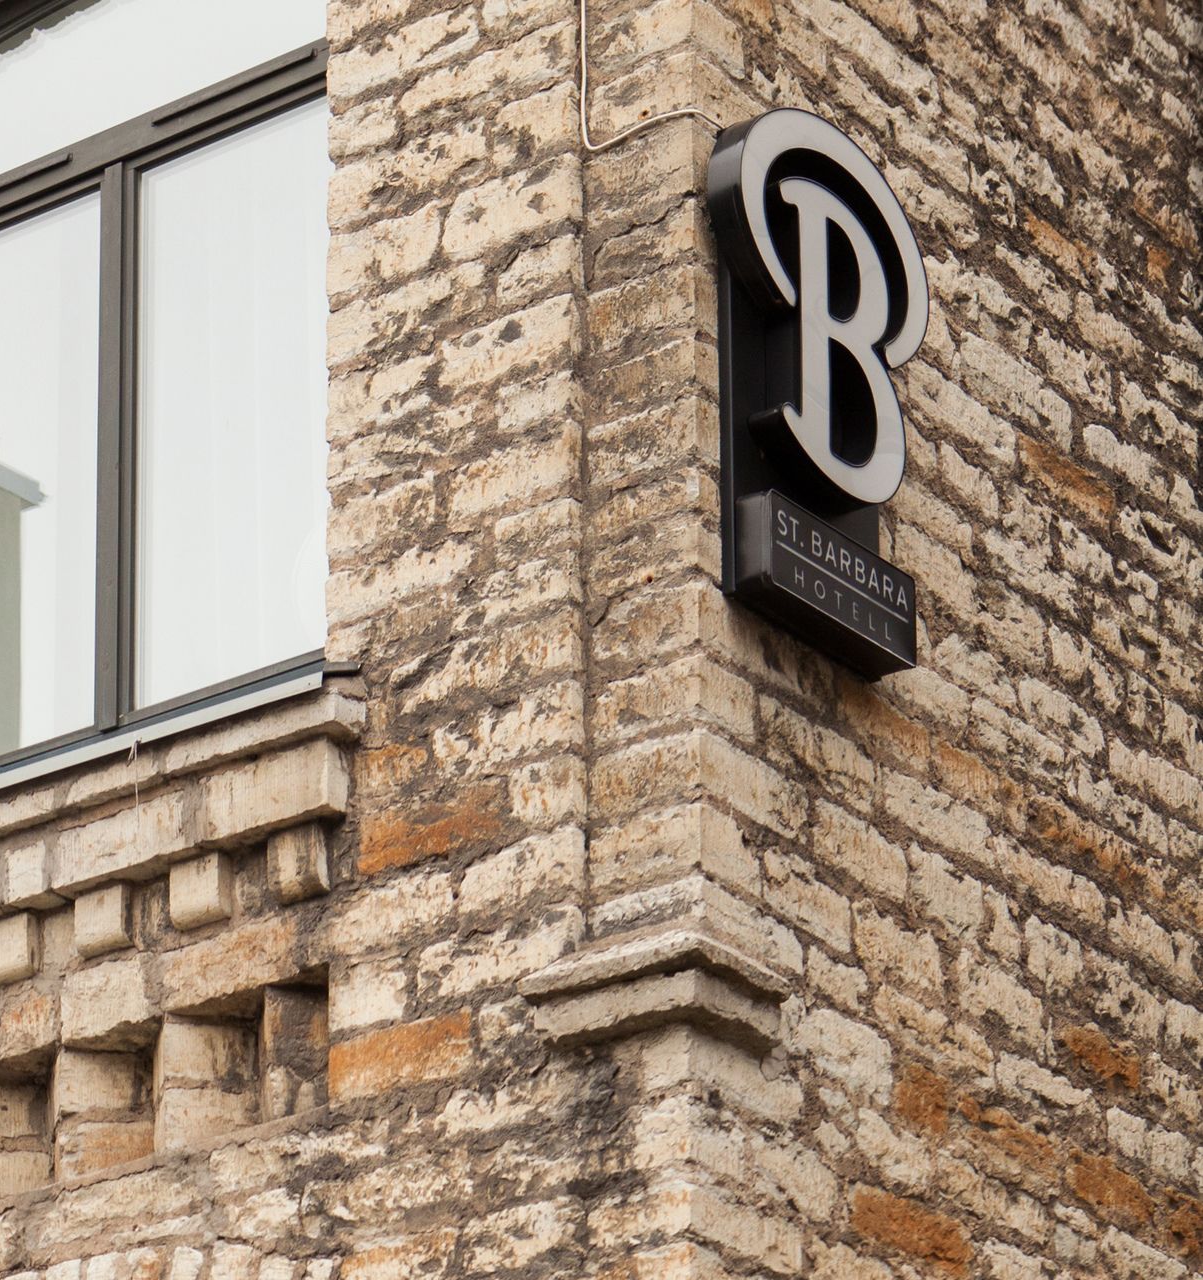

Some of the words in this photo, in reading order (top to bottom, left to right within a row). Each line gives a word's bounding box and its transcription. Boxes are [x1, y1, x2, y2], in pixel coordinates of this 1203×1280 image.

[740, 107, 929, 505] B
[776, 508, 806, 549] ST.
[811, 529, 910, 613] BARBARA
[793, 567, 893, 643] HOTELL
